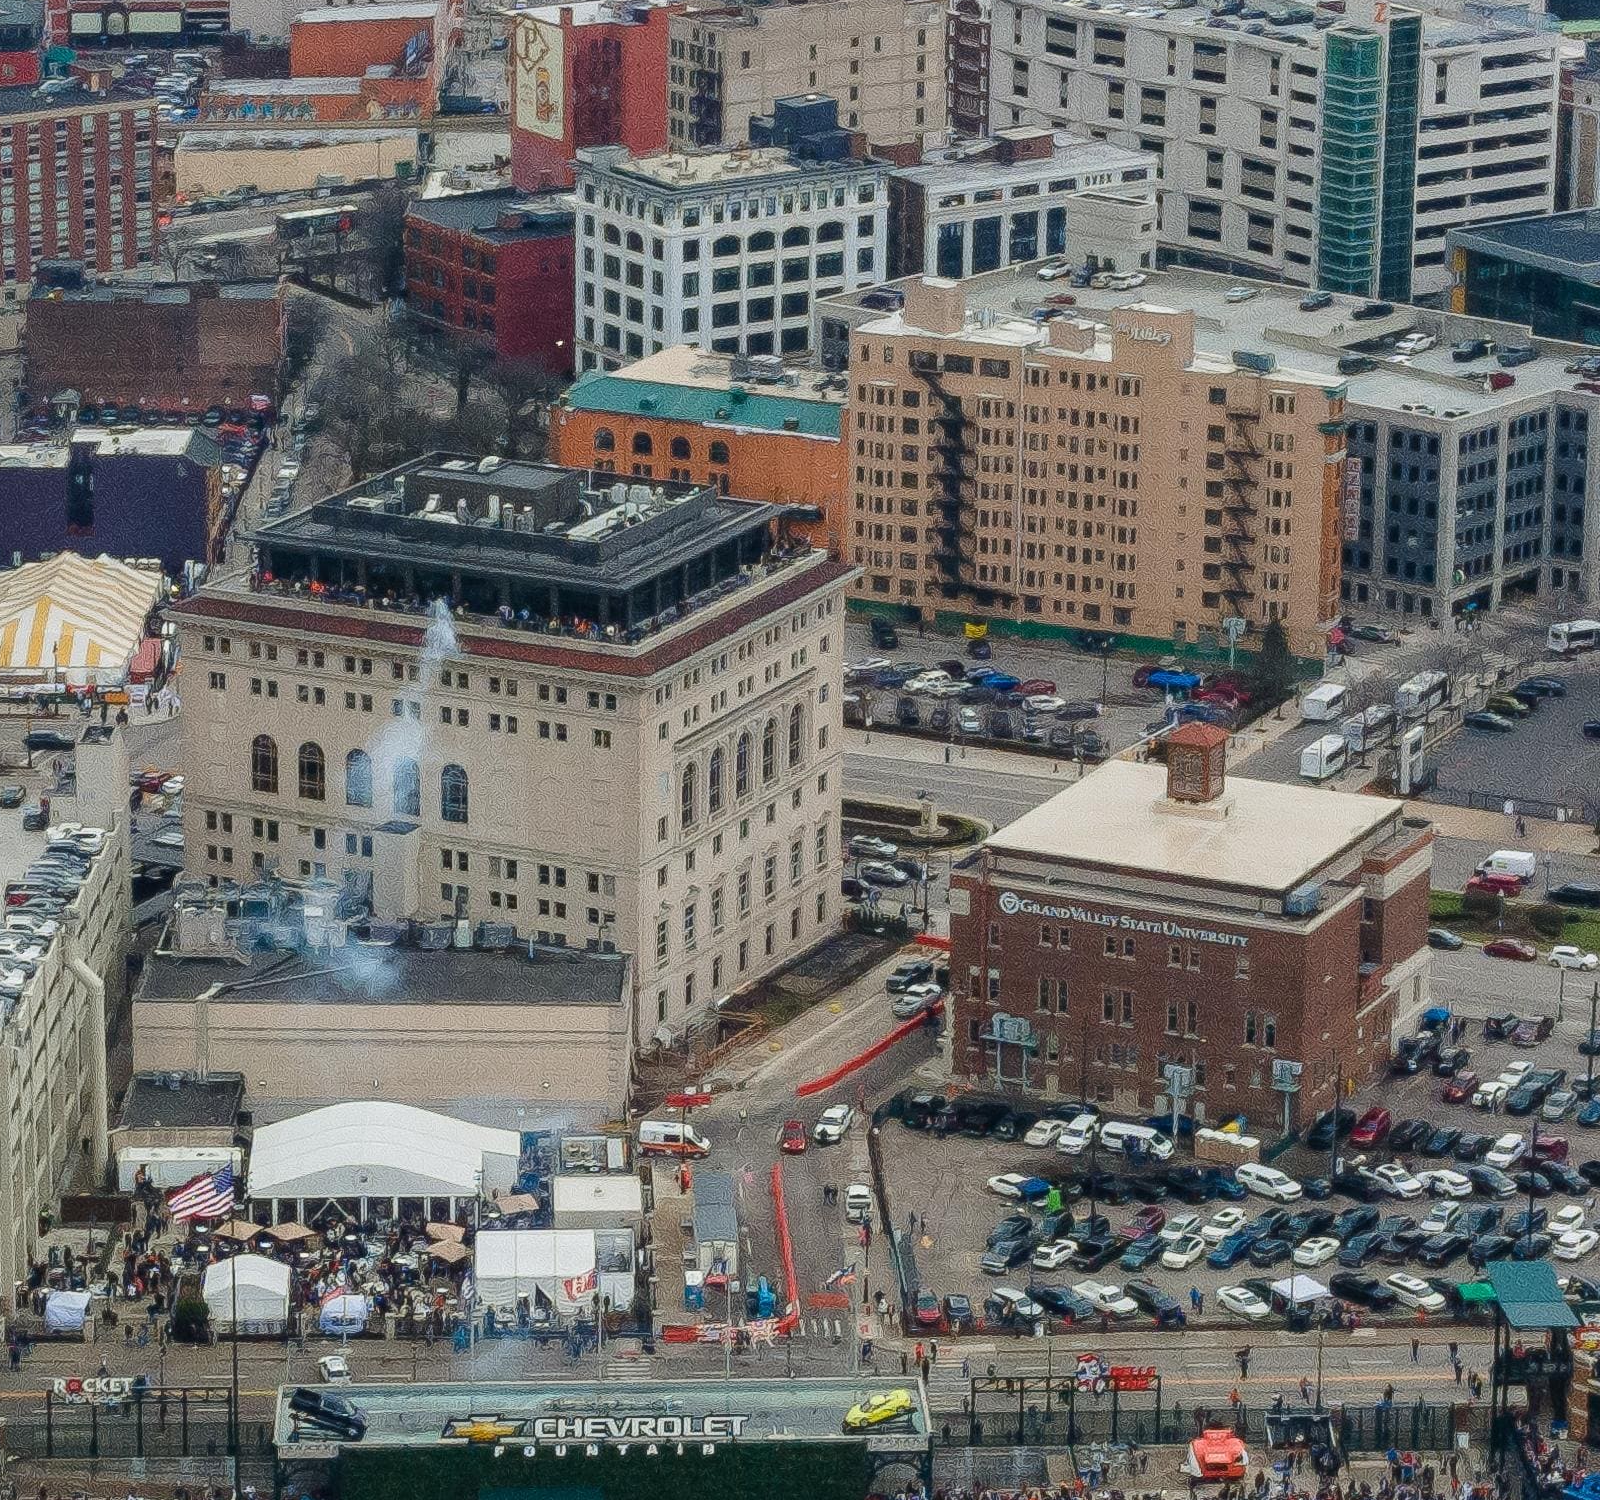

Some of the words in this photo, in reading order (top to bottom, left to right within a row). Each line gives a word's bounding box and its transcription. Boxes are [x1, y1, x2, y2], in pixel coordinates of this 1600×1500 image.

[1020, 900, 1070, 919] GRAND
[1070, 906, 1119, 928] VALLEY
[1119, 915, 1161, 934] STATE
[1162, 921, 1249, 947] UNIVERSITY
[534, 1416, 750, 1438] CHEVROLET
[494, 1444, 715, 1457] FOUNTAIN
